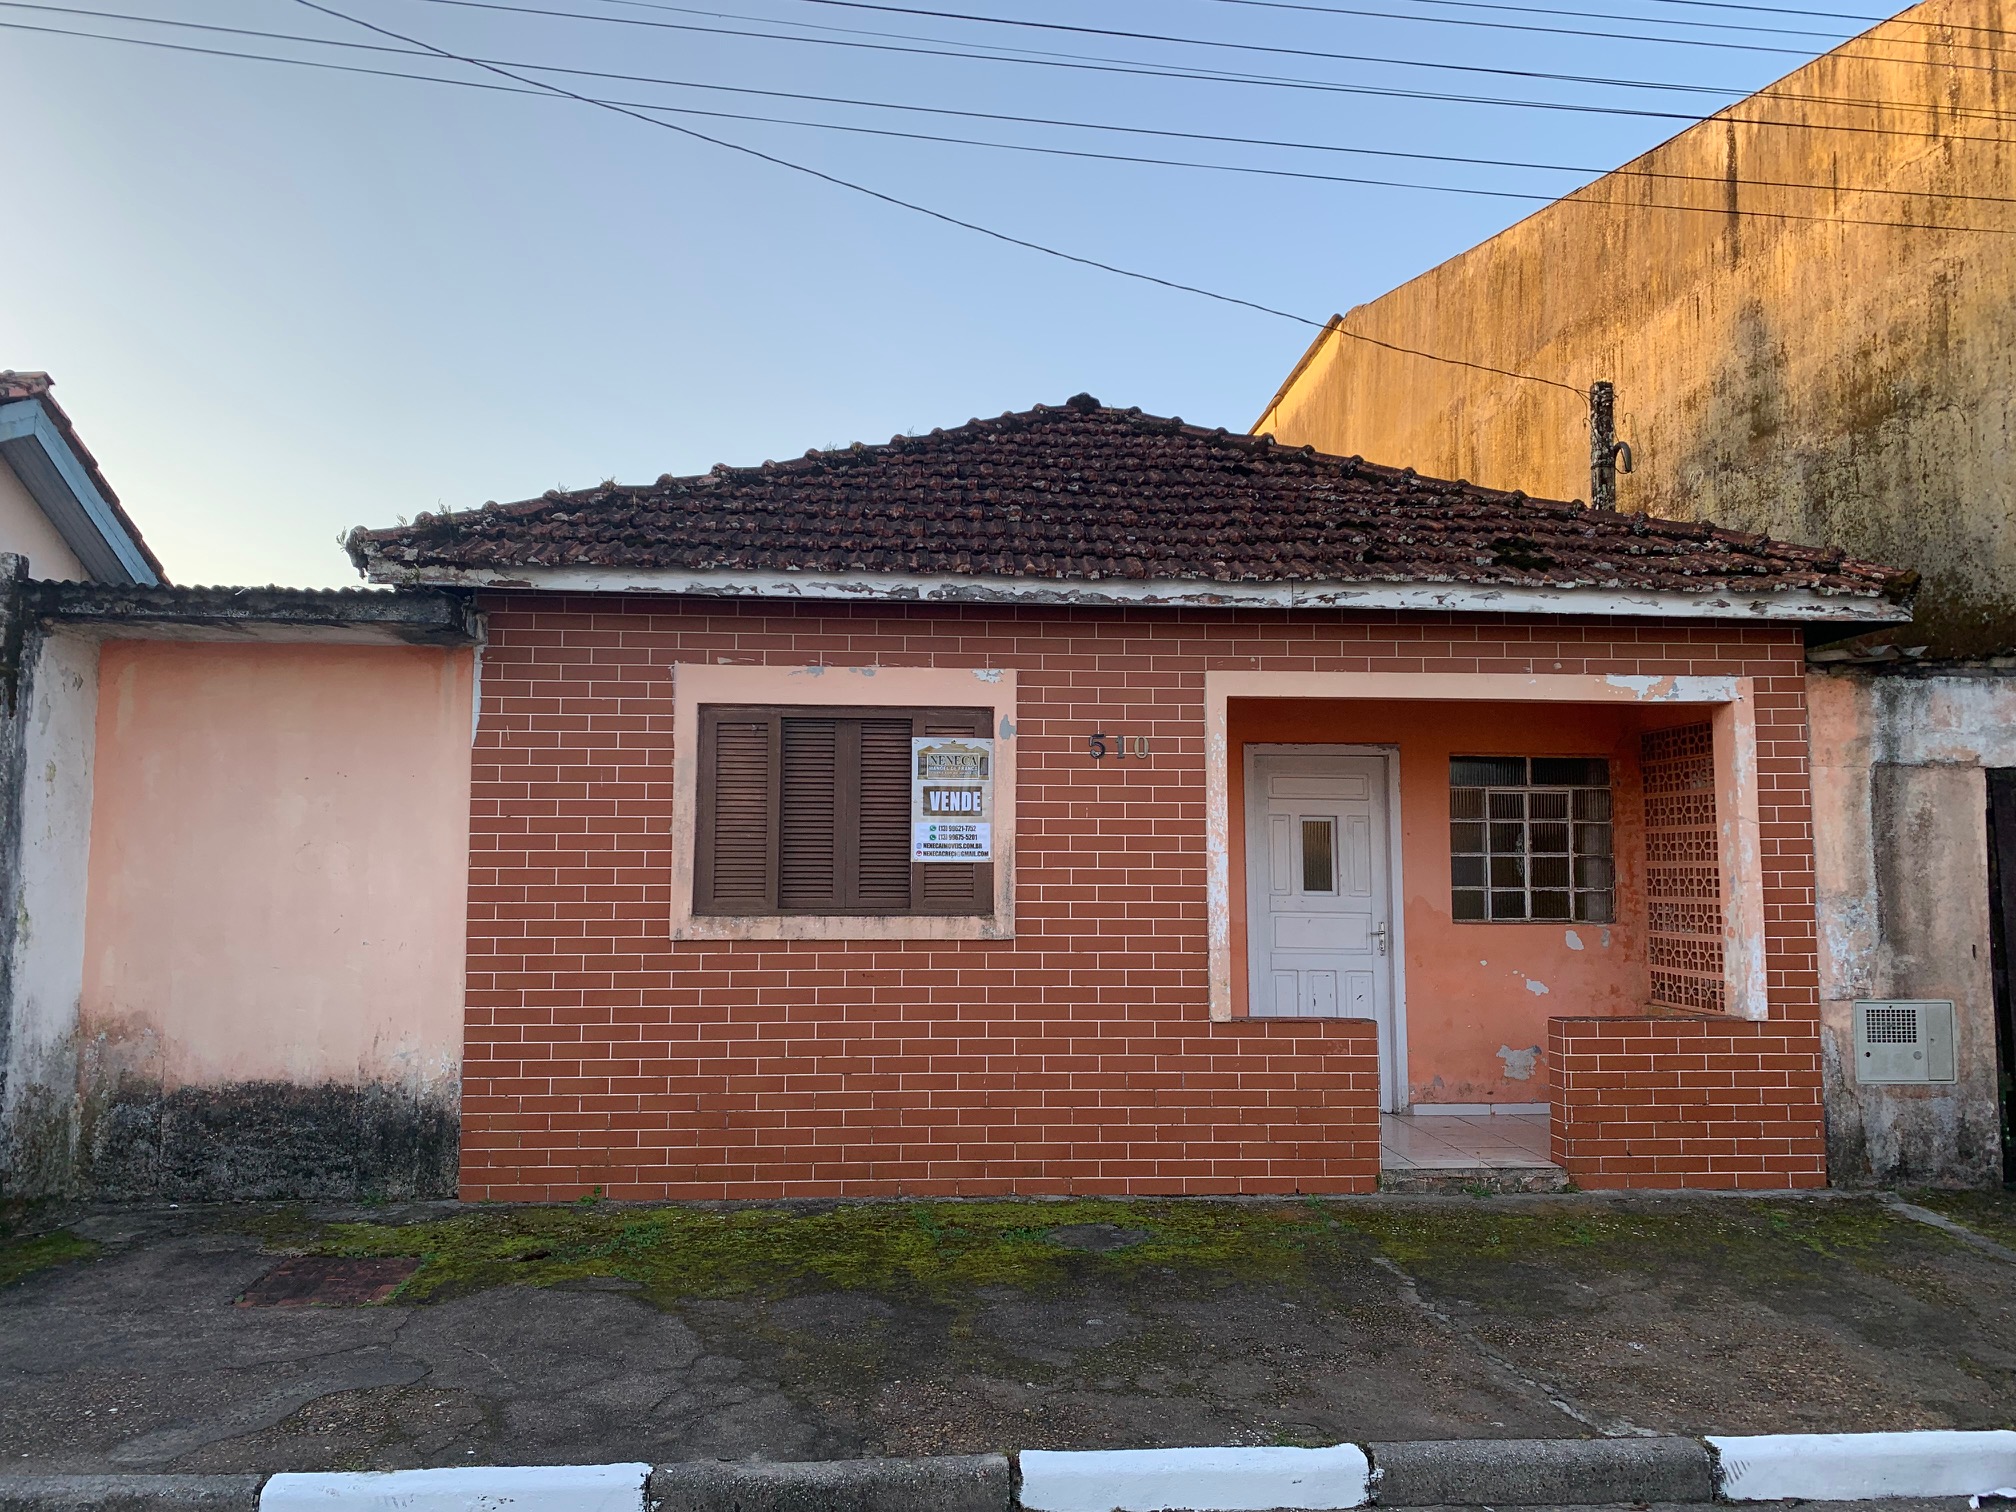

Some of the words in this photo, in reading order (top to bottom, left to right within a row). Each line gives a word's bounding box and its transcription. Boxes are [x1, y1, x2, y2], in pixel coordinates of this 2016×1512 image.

[1089, 733, 1149, 760] 510
[930, 755, 977, 766] NENECA
[929, 791, 981, 812] VENDE
[938, 833, 948, 841] (13)
